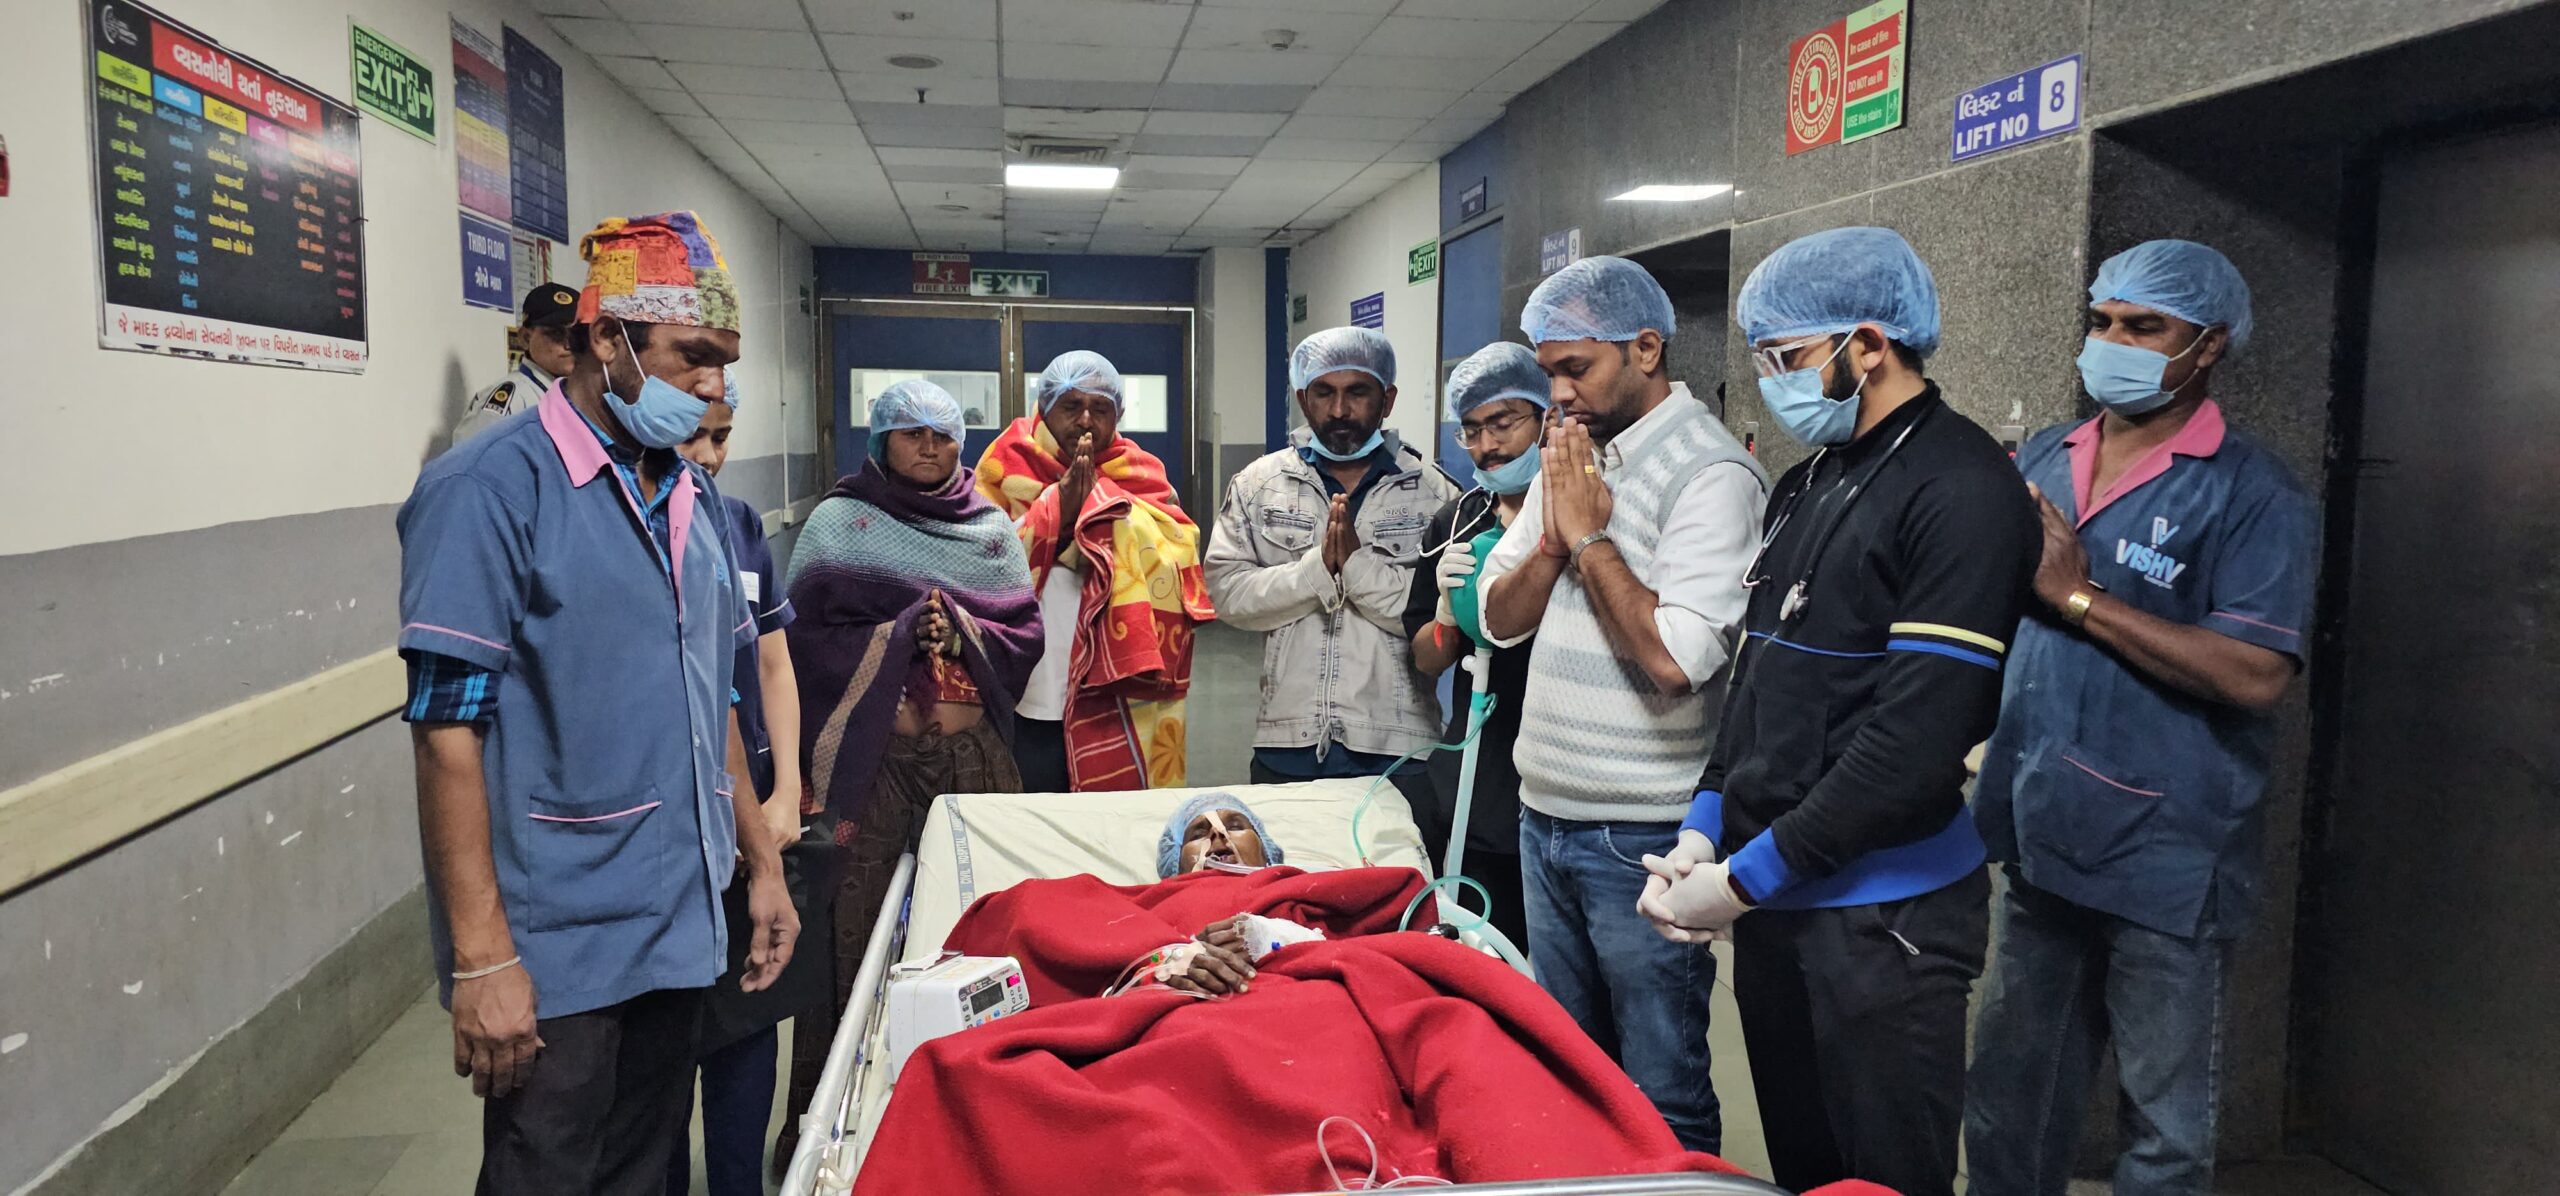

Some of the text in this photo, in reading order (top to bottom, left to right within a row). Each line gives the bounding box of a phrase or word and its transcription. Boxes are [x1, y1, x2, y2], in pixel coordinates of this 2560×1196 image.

[355, 29, 405, 70] EMERGENCY
[1857, 39, 1871, 52] case
[1871, 32, 1879, 47] of
[356, 49, 406, 105] EXIT
[1793, 40, 1838, 95] FIRE EXTINGUISHER
[1857, 75, 1868, 90] NOT
[2050, 80, 2065, 112] 8
[1803, 125, 1819, 138] AREA
[1818, 96, 1835, 130] CLEAR
[1846, 114, 1858, 128] USE
[1956, 113, 2029, 154] LIFT NO
[467, 231, 487, 255] THIRD
[487, 237, 506, 261] FLOOR
[1571, 237, 1577, 255] 9
[1418, 251, 1436, 273] EXIT
[1542, 253, 1566, 272] LIFT NO
[914, 284, 968, 293] FIRE EXIT
[976, 274, 1043, 295] EXIT
[2115, 538, 2187, 584] VISHV
[955, 835, 970, 865] HOSPITAL
[959, 868, 972, 885] CIVIL
